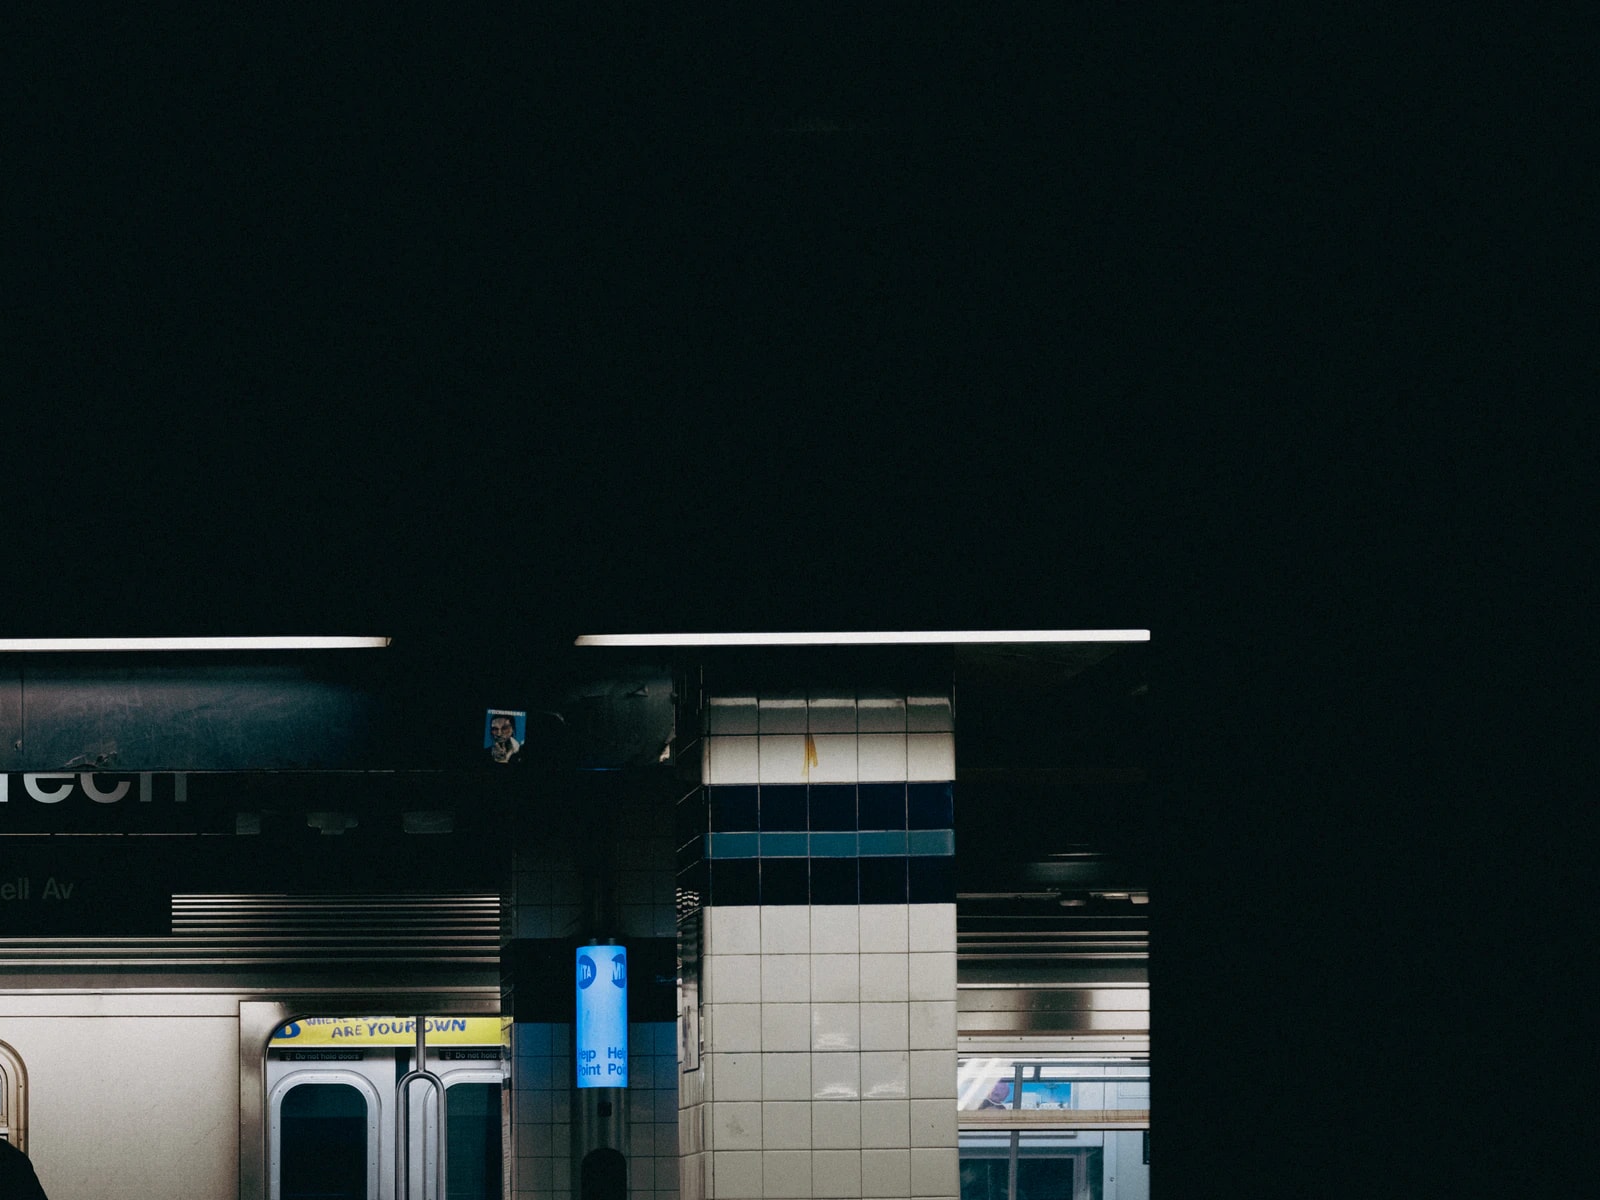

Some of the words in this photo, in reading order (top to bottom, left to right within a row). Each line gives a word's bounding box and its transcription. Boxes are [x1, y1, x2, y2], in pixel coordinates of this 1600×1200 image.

[41, 877, 74, 901] Av
[331, 1025, 362, 1038] ARE
[367, 1021, 417, 1036] YOUR
[425, 1019, 467, 1033] OWN
